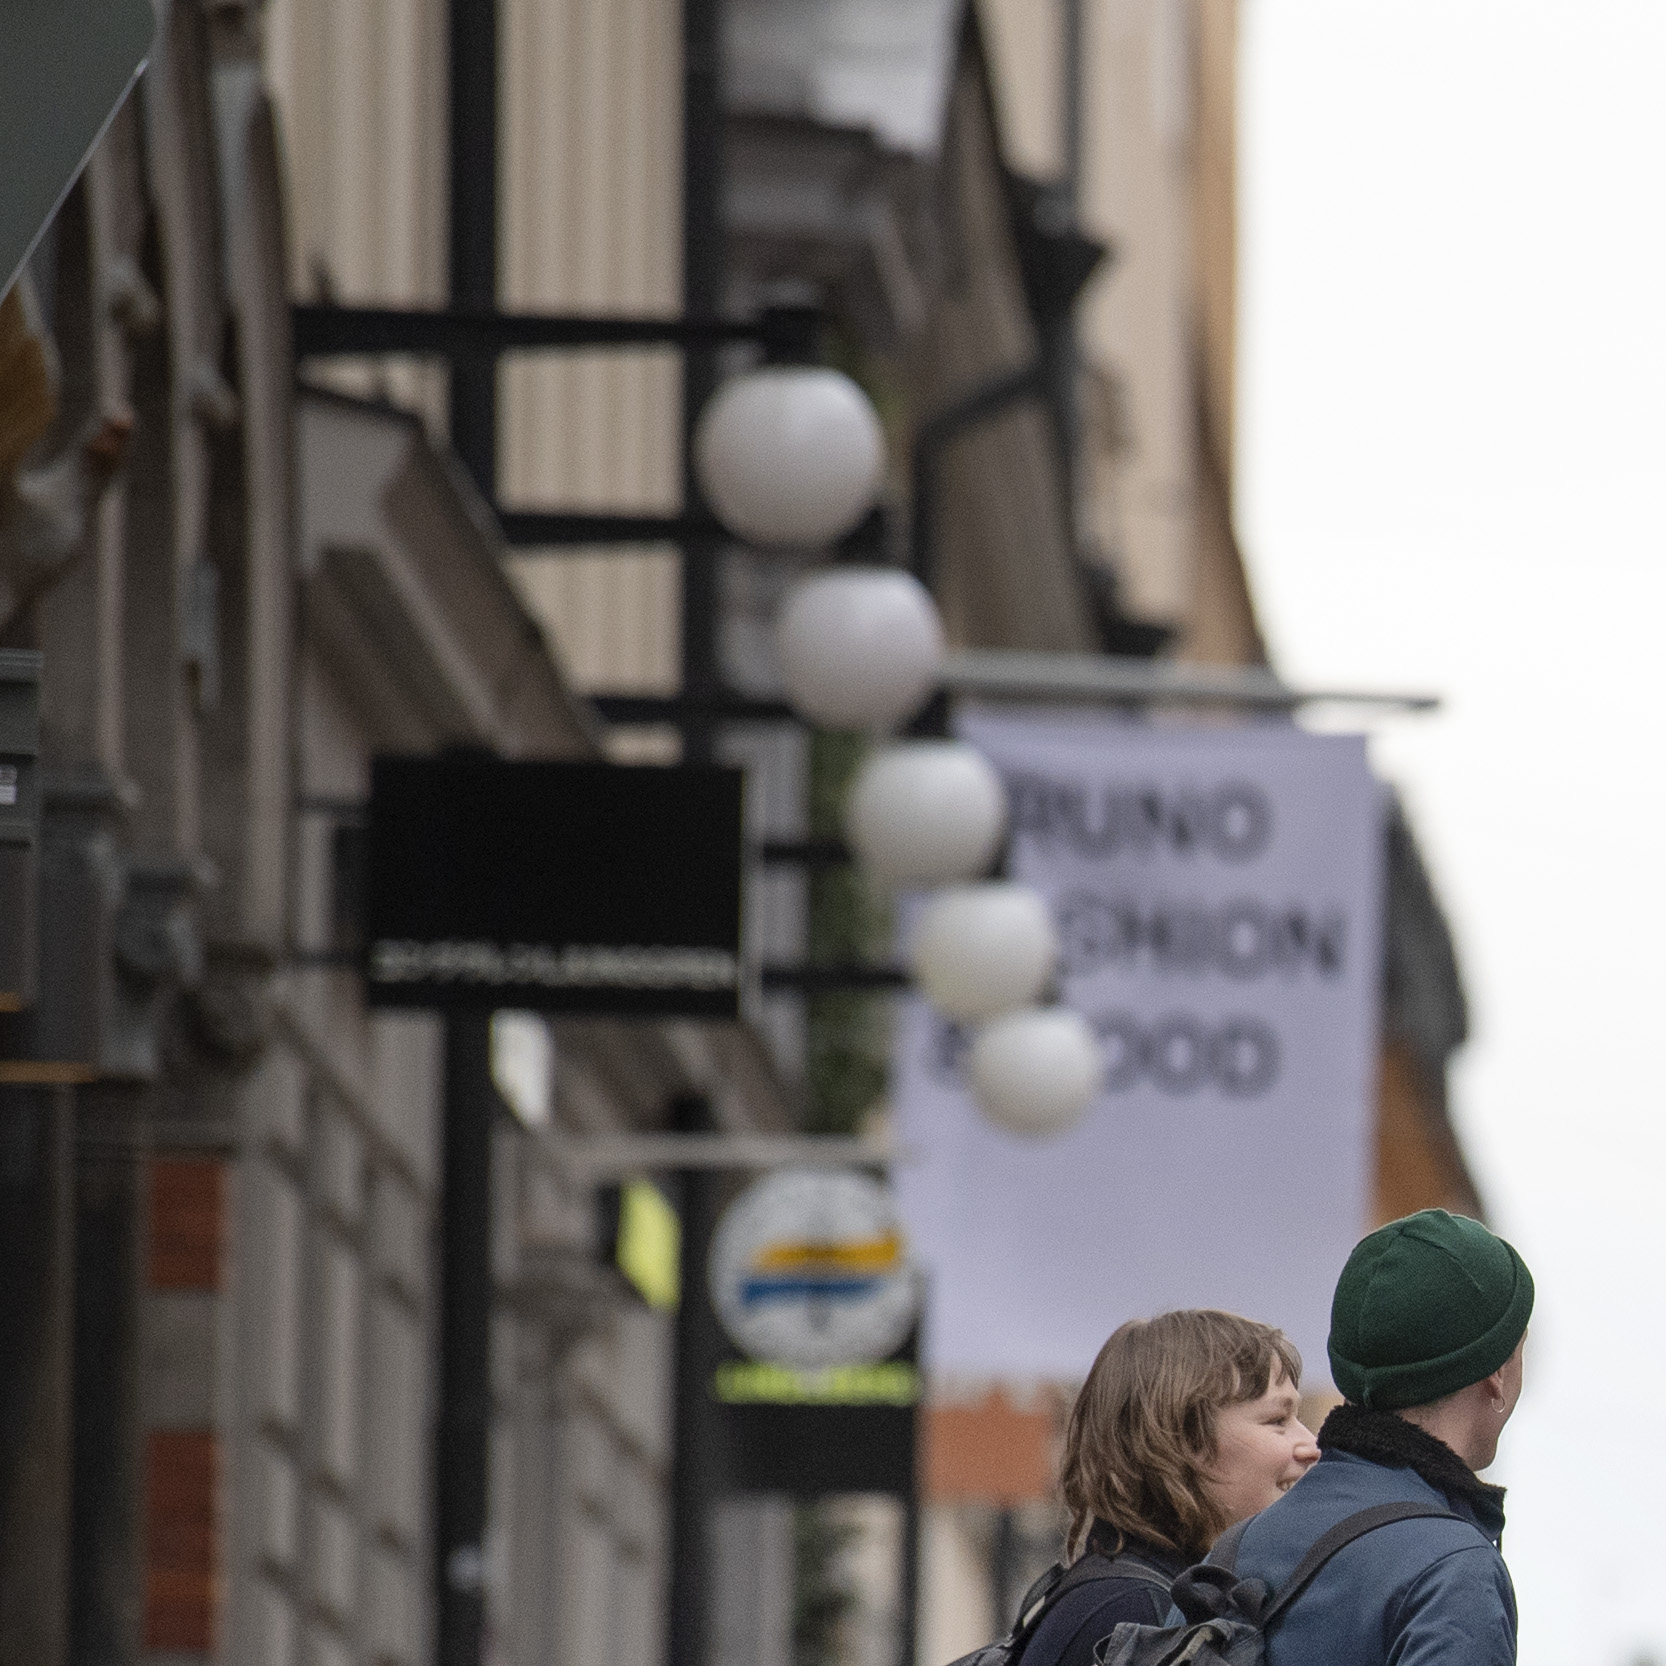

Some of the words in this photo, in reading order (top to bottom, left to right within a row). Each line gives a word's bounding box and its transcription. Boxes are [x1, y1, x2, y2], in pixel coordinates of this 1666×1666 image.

[1004, 772, 1275, 862] RUNO
[1054, 892, 1346, 982] SHION
[1094, 1010, 1281, 1097] OOD
